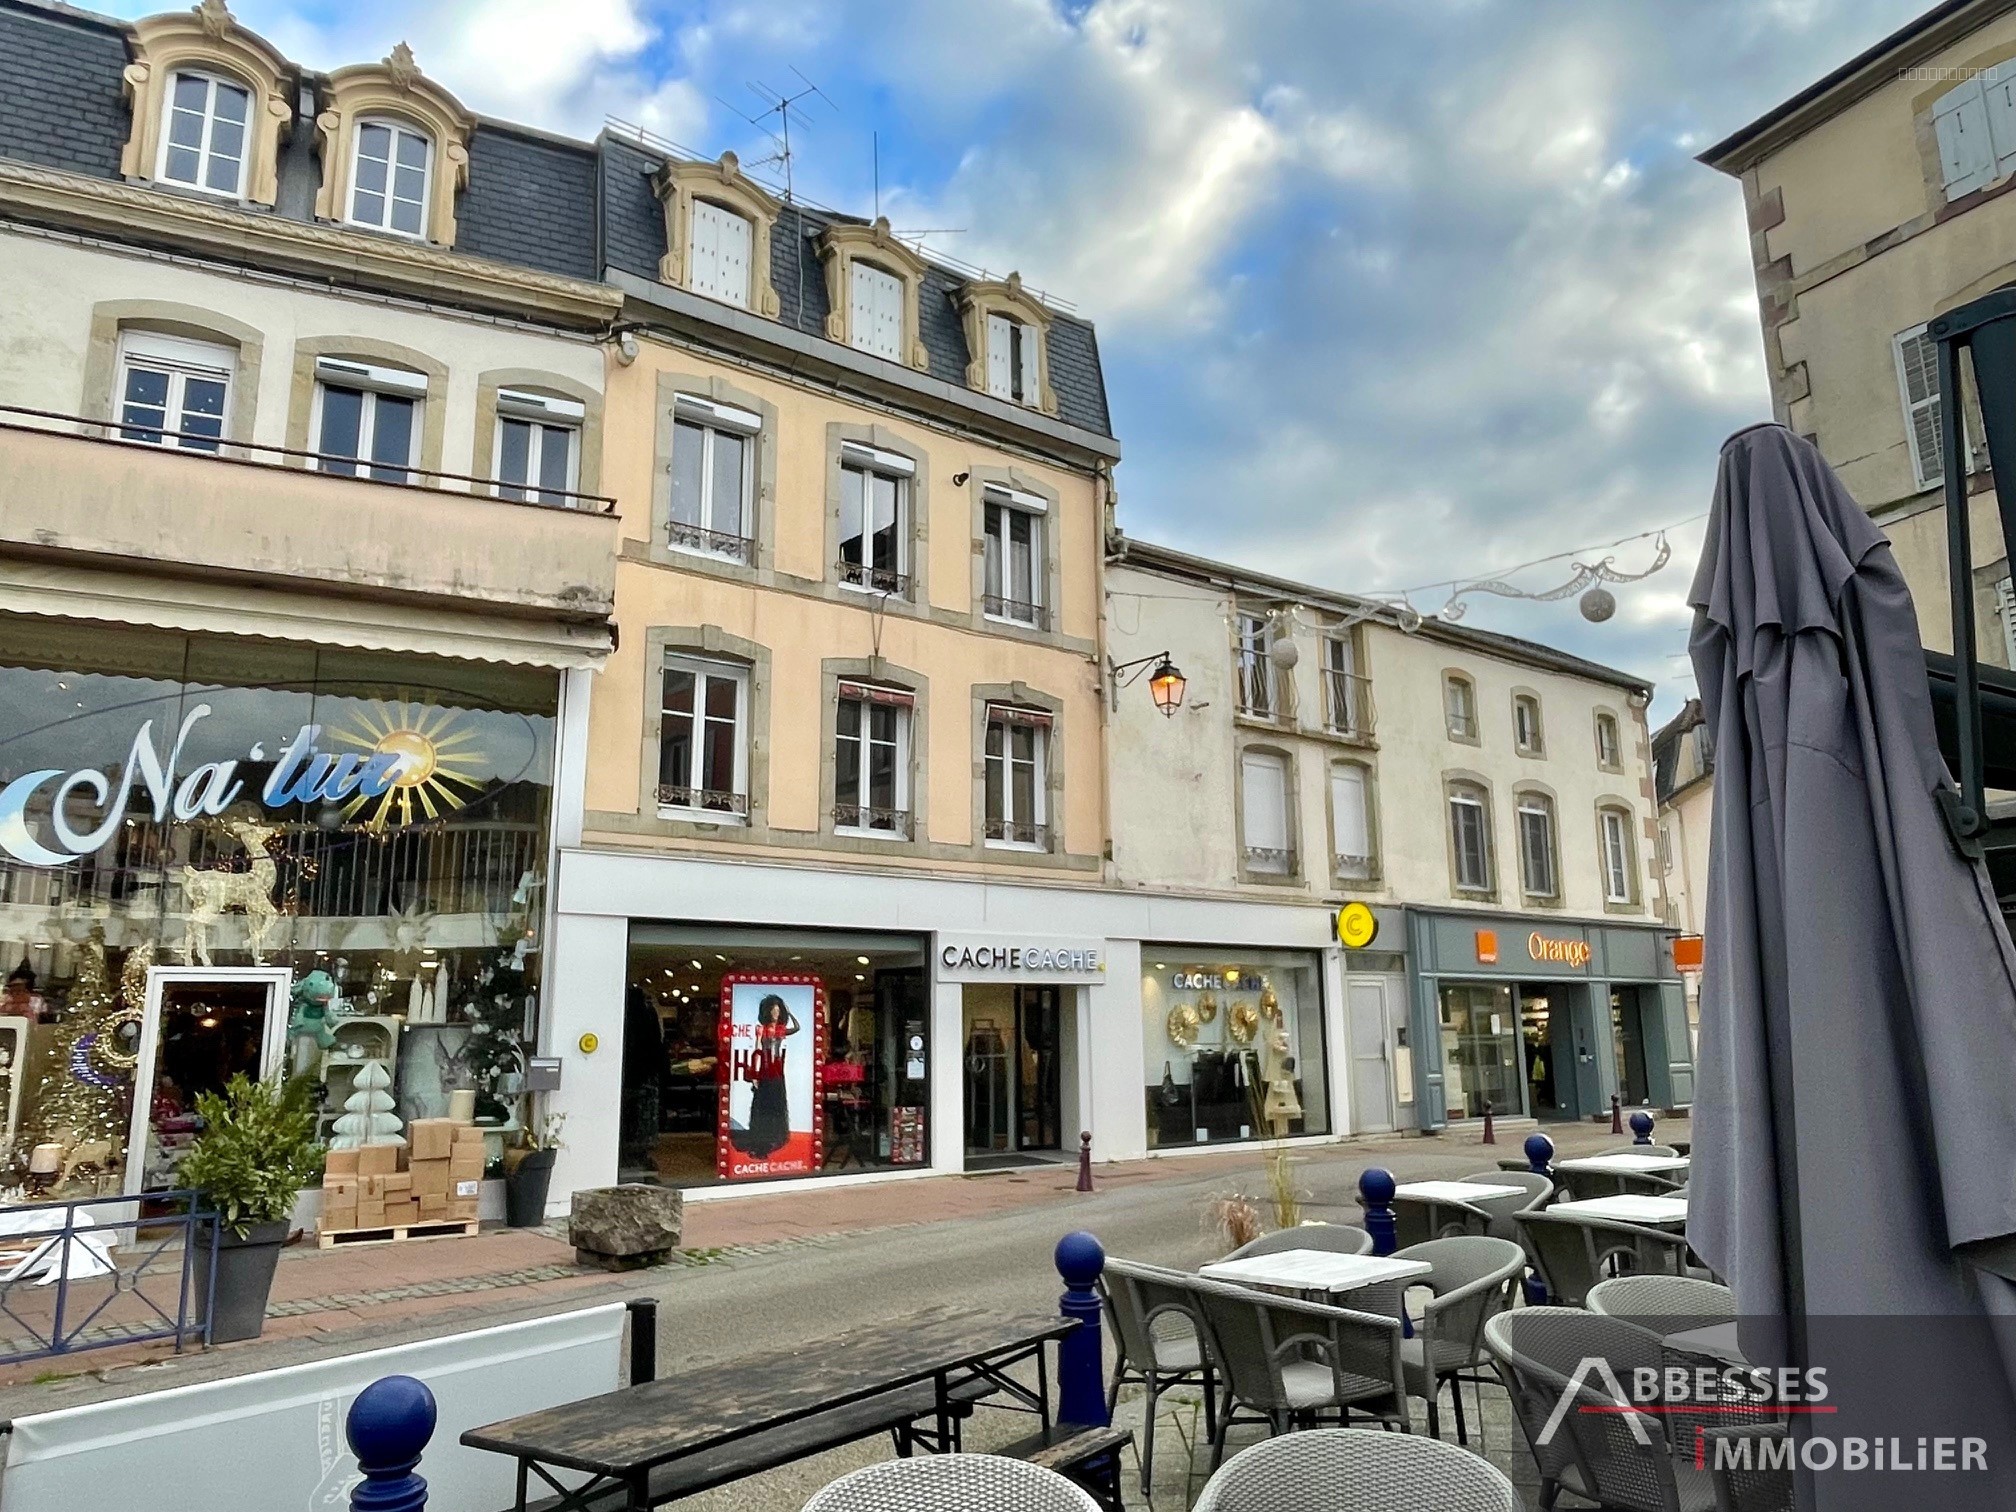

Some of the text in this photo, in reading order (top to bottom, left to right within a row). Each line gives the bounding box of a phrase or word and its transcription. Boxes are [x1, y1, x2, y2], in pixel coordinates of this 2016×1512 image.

[1346, 913, 1363, 936] C
[942, 945, 1097, 971] CACHE CACHE
[1528, 931, 1590, 968] Orange
[1173, 973, 1222, 990] CACHE
[733, 1162, 769, 1175] CACHE
